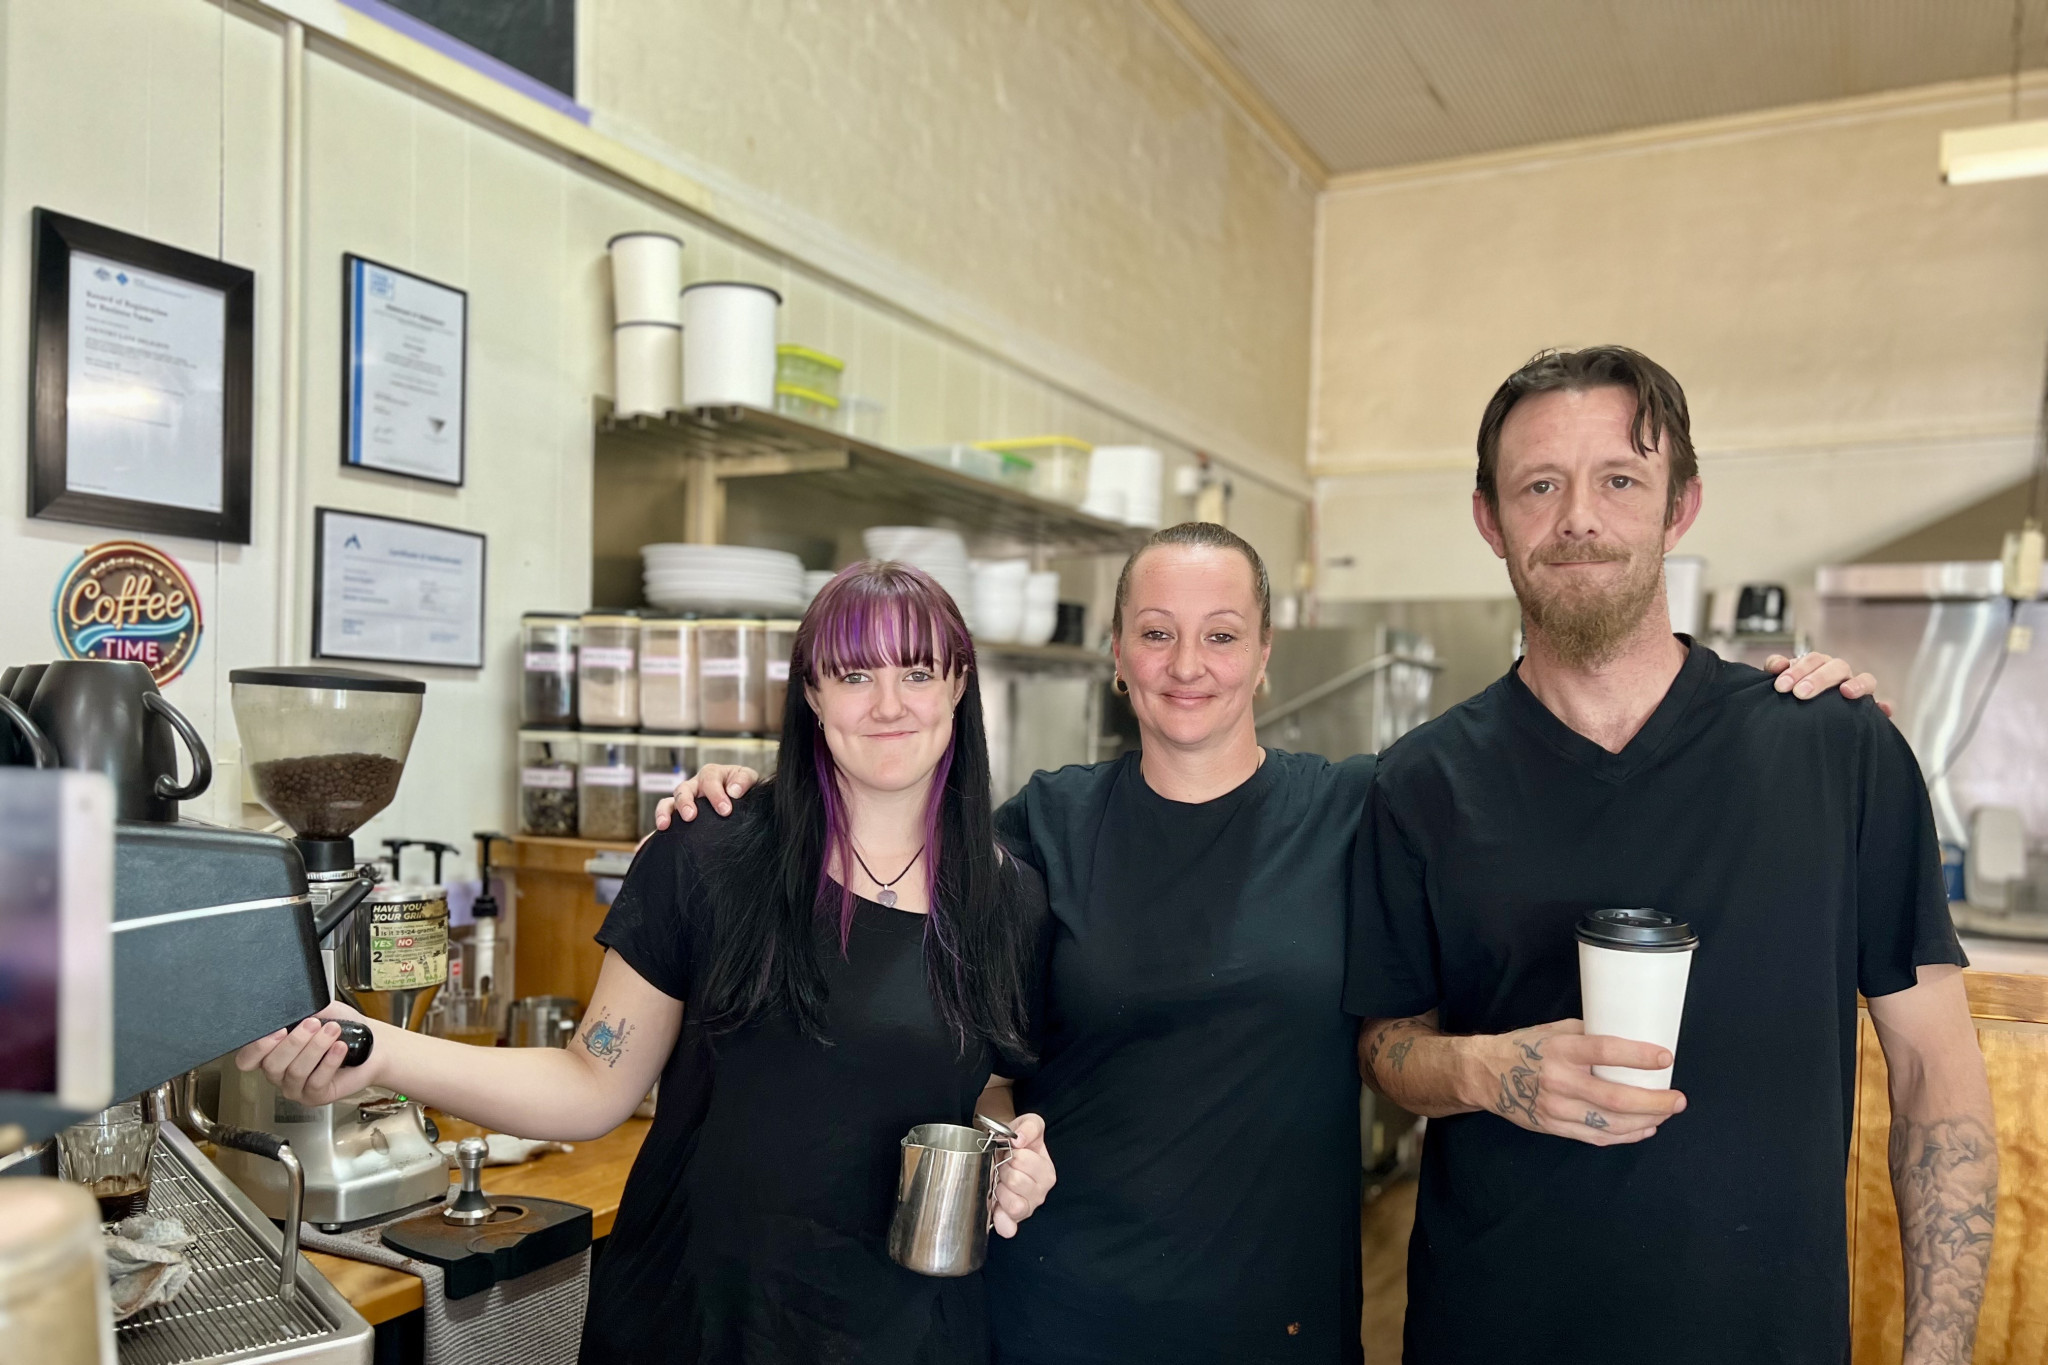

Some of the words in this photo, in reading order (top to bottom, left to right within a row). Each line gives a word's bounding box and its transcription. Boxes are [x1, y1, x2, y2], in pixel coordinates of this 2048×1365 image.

[69, 574, 185, 629] Coffee
[102, 637, 158, 662] TIME
[373, 905, 401, 913] HAVE
[403, 903, 422, 911] YOU
[373, 913, 401, 921] YOUR
[373, 926, 379, 936] 1
[374, 940, 392, 948] YES
[373, 951, 383, 962] 2
